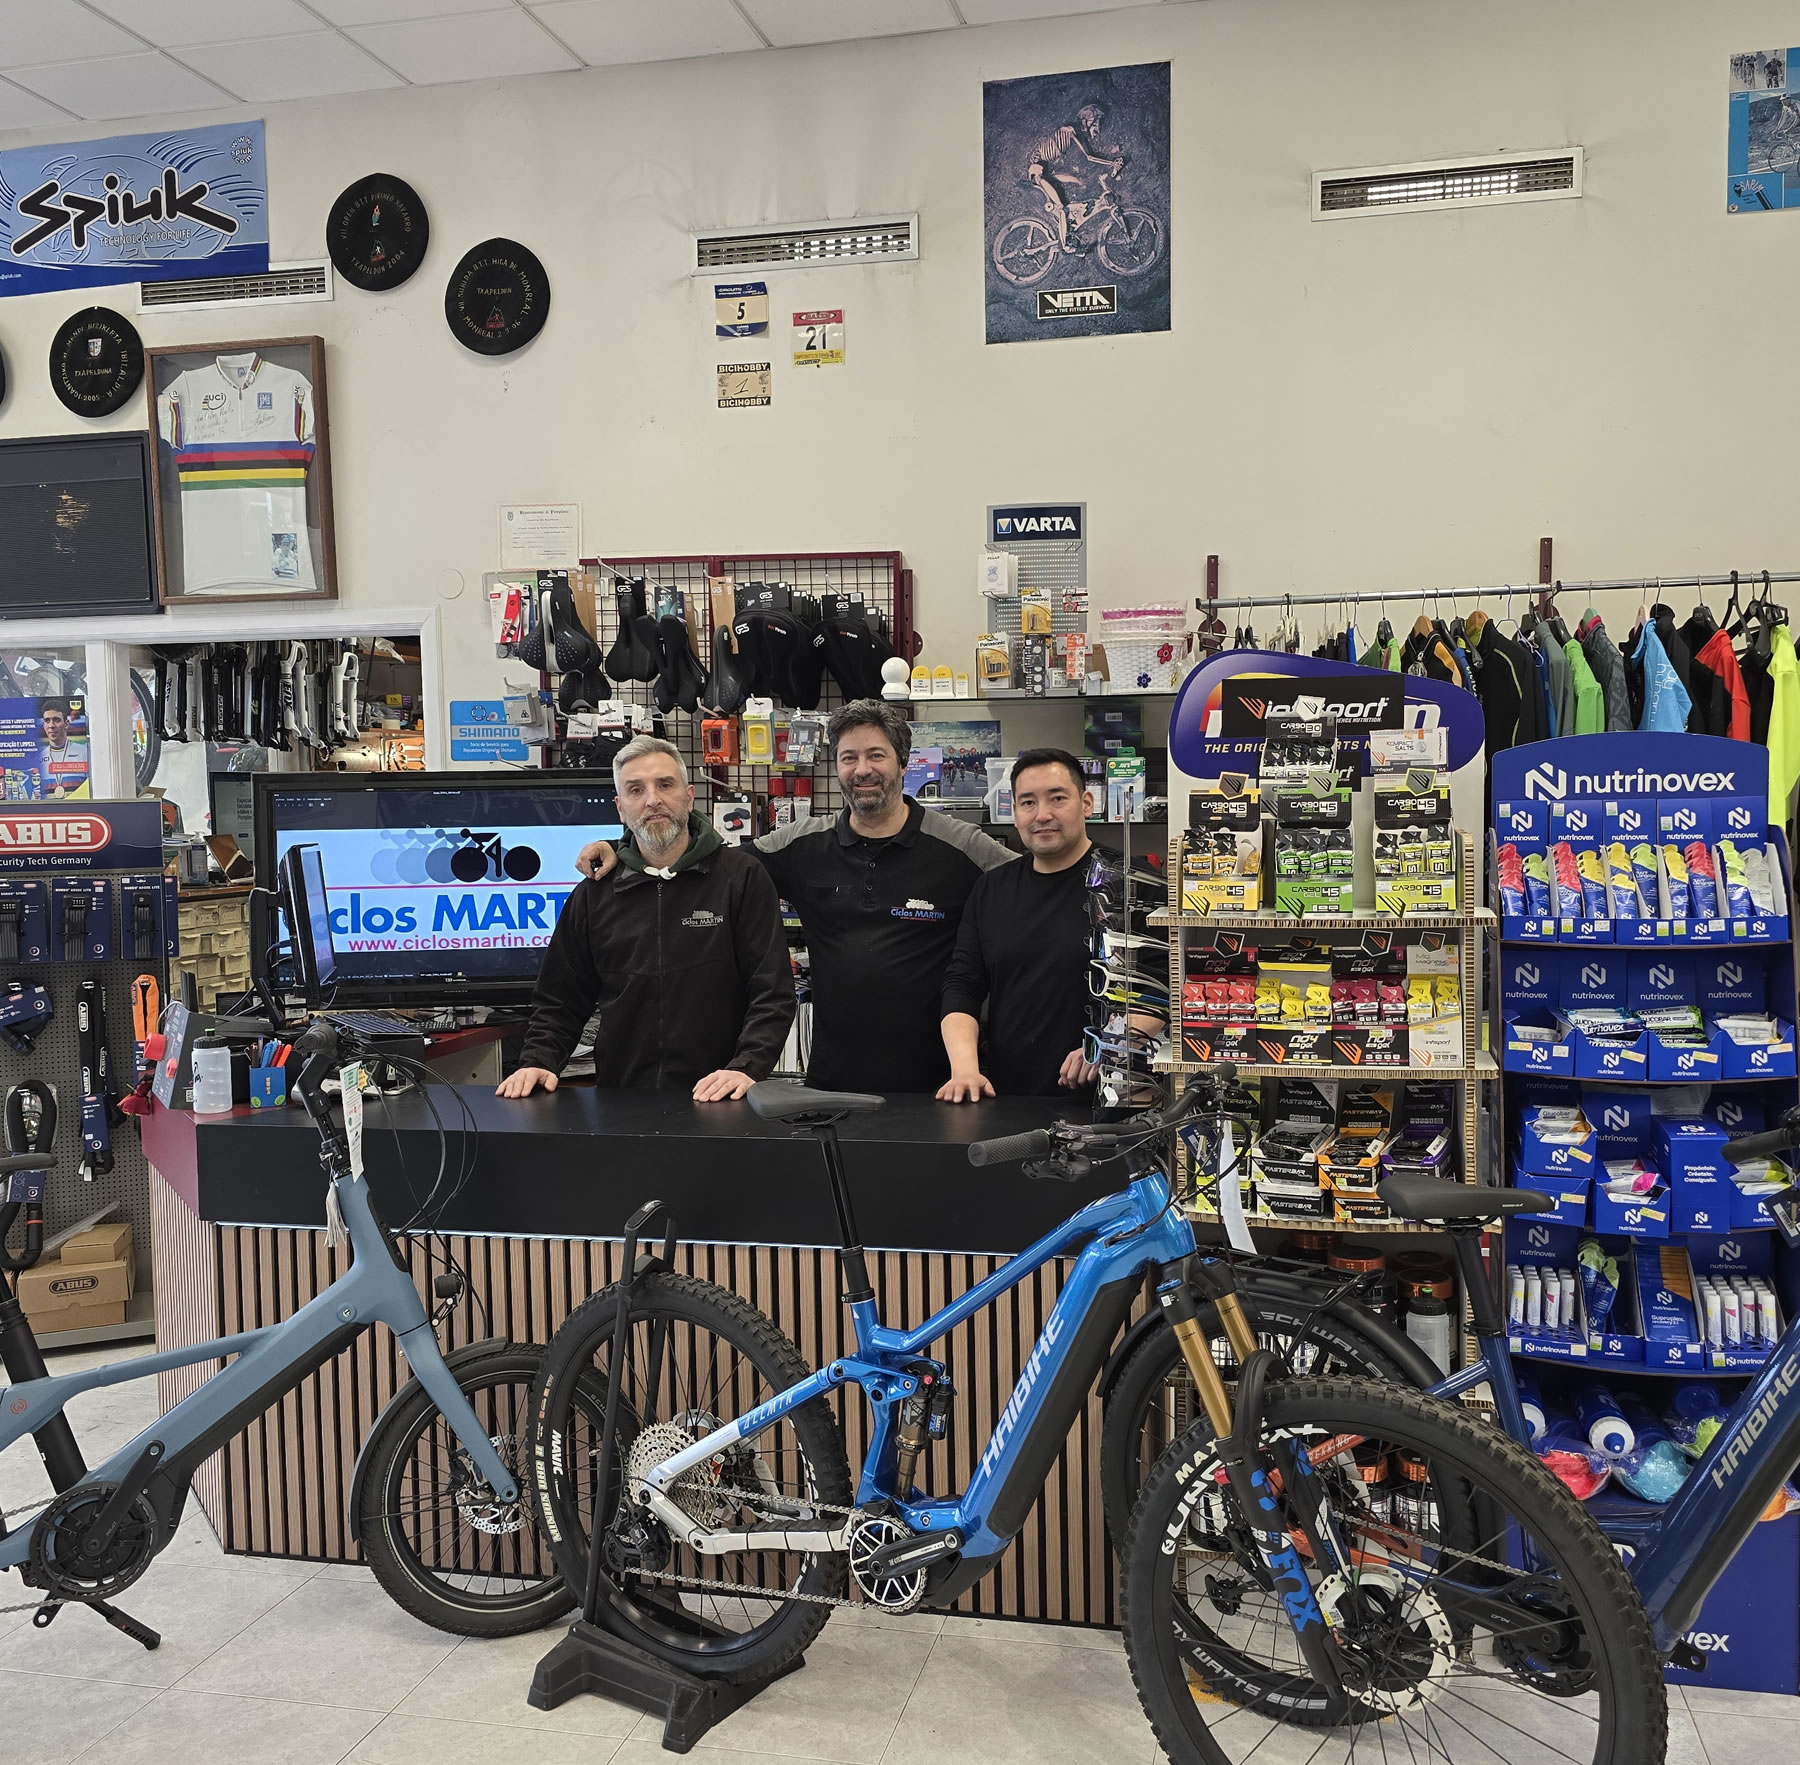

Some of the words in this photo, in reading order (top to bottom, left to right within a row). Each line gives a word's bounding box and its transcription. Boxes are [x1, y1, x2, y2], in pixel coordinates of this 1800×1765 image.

[343, 208, 355, 226] OPEN
[395, 200, 412, 232] NAVARRO
[99, 231, 154, 247] TECHNOLOGY
[157, 231, 173, 242] FOR
[175, 229, 192, 240] LIFE
[351, 257, 385, 275] TXAPELDUN
[387, 250, 405, 268] 2004
[458, 270, 472, 298] SUBIDA
[492, 258, 507, 266] HIGA
[1044, 291, 1110, 308] VETTA
[737, 302, 745, 320] 5
[463, 316, 495, 338] MONREAL
[806, 325, 826, 350] 21
[88, 323, 122, 344] BIZIKLETA
[106, 350, 127, 397] IBILALDIA
[75, 368, 112, 376] TXAPELDUNA
[720, 398, 768, 407] BICIHOBBY
[1013, 516, 1076, 533] VARTA
[759, 591, 772, 600] GES
[836, 601, 849, 609] GES
[735, 623, 750, 634] GES
[459, 727, 520, 738] SHIMANO
[1306, 724, 1321, 733] 30
[1204, 743, 1224, 754] THE
[1234, 742, 1265, 753] ORIG
[1336, 740, 1359, 751] RTS
[1574, 768, 1735, 794] nutrinovex
[1229, 802, 1246, 813] 45
[1319, 802, 1337, 812] 45
[1418, 799, 1436, 810] 45
[0, 823, 91, 844] ABUS
[0, 858, 24, 867] curity
[51, 857, 92, 865] Germany
[1227, 886, 1244, 896] 45
[1322, 888, 1339, 896] 45
[1423, 885, 1441, 895] 45
[330, 893, 416, 934] clos
[432, 892, 571, 930] MART
[890, 909, 913, 917] Ciclos
[914, 910, 944, 919] MARTIN
[700, 916, 724, 925] MARTIN
[349, 935, 551, 952] www.ciclosmartin.co
[1506, 991, 1548, 1000] nutrinovex
[1572, 992, 1615, 1000] nutrinovex
[1640, 993, 1684, 1001] nutrinovex
[1708, 991, 1752, 999] nutrinovex
[1526, 1082, 1568, 1090] nutrinovex
[1264, 1166, 1306, 1174] FASTERBAR
[1520, 1249, 1556, 1258] nutrinovex
[55, 1278, 92, 1290] ABUS
[1258, 1310, 1386, 1380] SCHWALB
[1535, 1344, 1569, 1354] nutrinovex
[980, 1303, 1065, 1480] HAIBIKE
[743, 1391, 793, 1431] ALLMTN
[1711, 1354, 1799, 1490] HAIBIKE
[552, 1429, 564, 1476] MAVIC
[1268, 1545, 1322, 1632] FOX
[1192, 1646, 1262, 1696] WATTS
